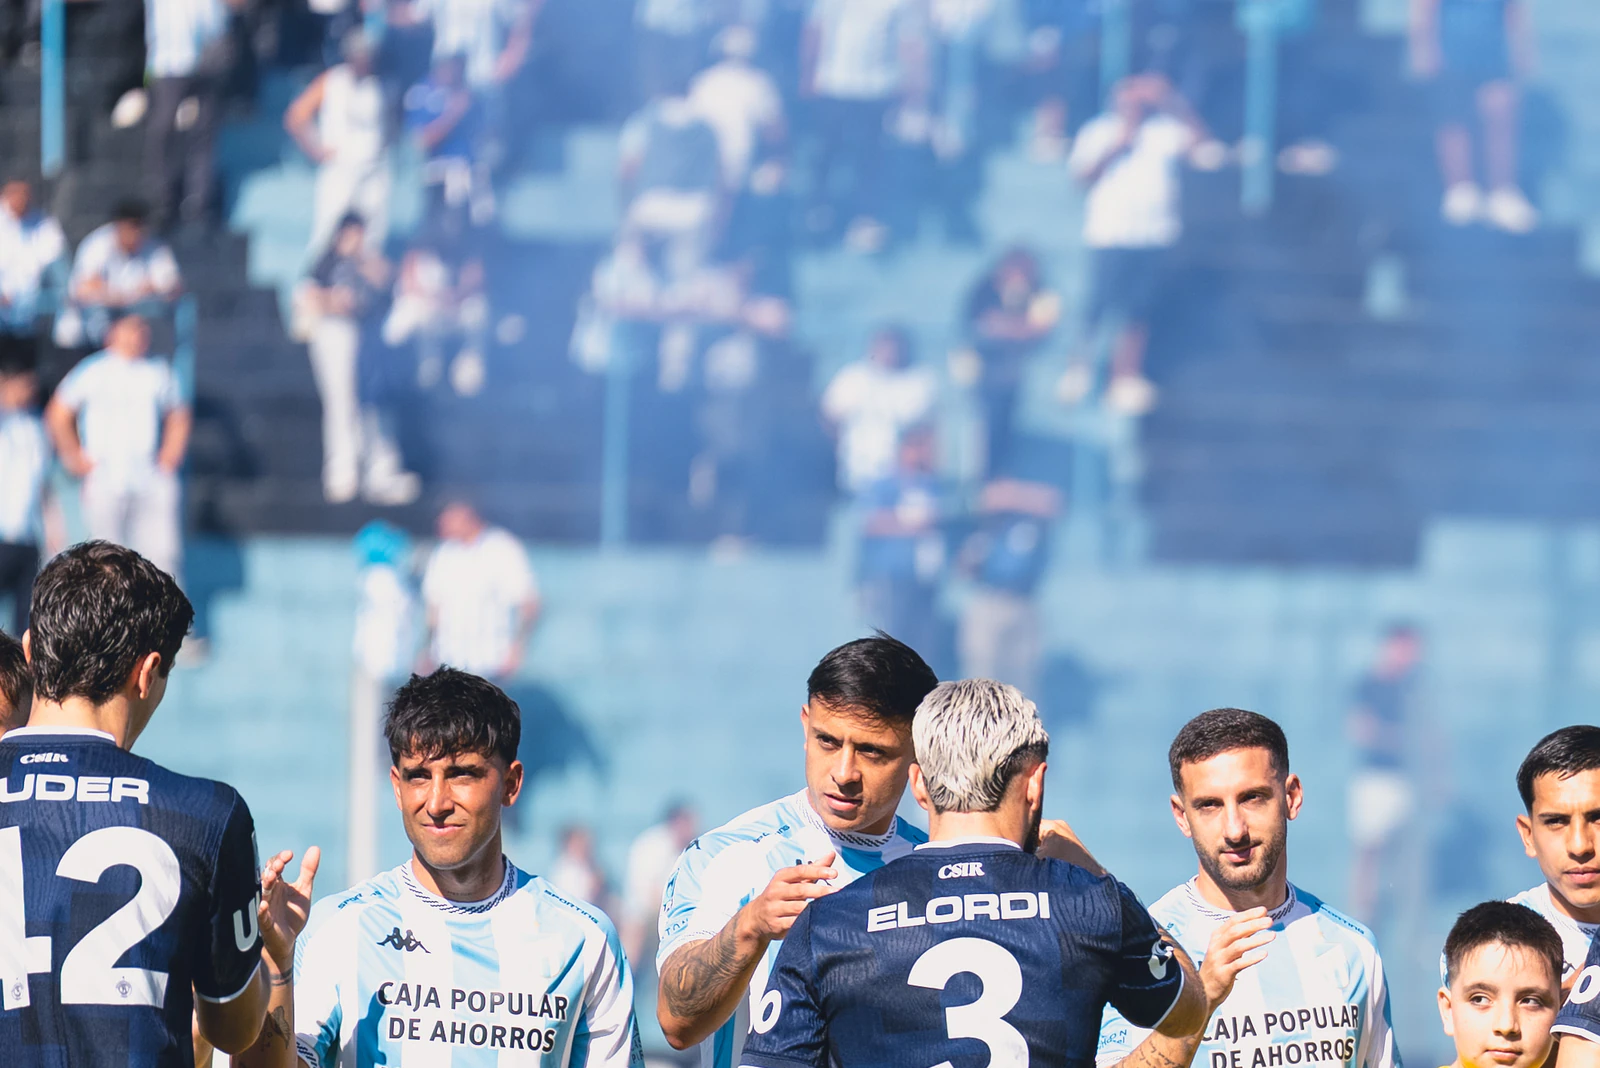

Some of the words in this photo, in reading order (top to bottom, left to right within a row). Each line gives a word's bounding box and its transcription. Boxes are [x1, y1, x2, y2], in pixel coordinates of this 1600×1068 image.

[938, 861, 985, 880] CSIR
[544, 889, 600, 924] SPORTING
[866, 891, 1051, 933] ELORDI
[378, 982, 441, 1012] CAJA
[451, 988, 569, 1021] POPULAR
[388, 1017, 421, 1041] DE
[429, 1020, 556, 1053] AHORROS
[1263, 1005, 1359, 1035] POPULAR
